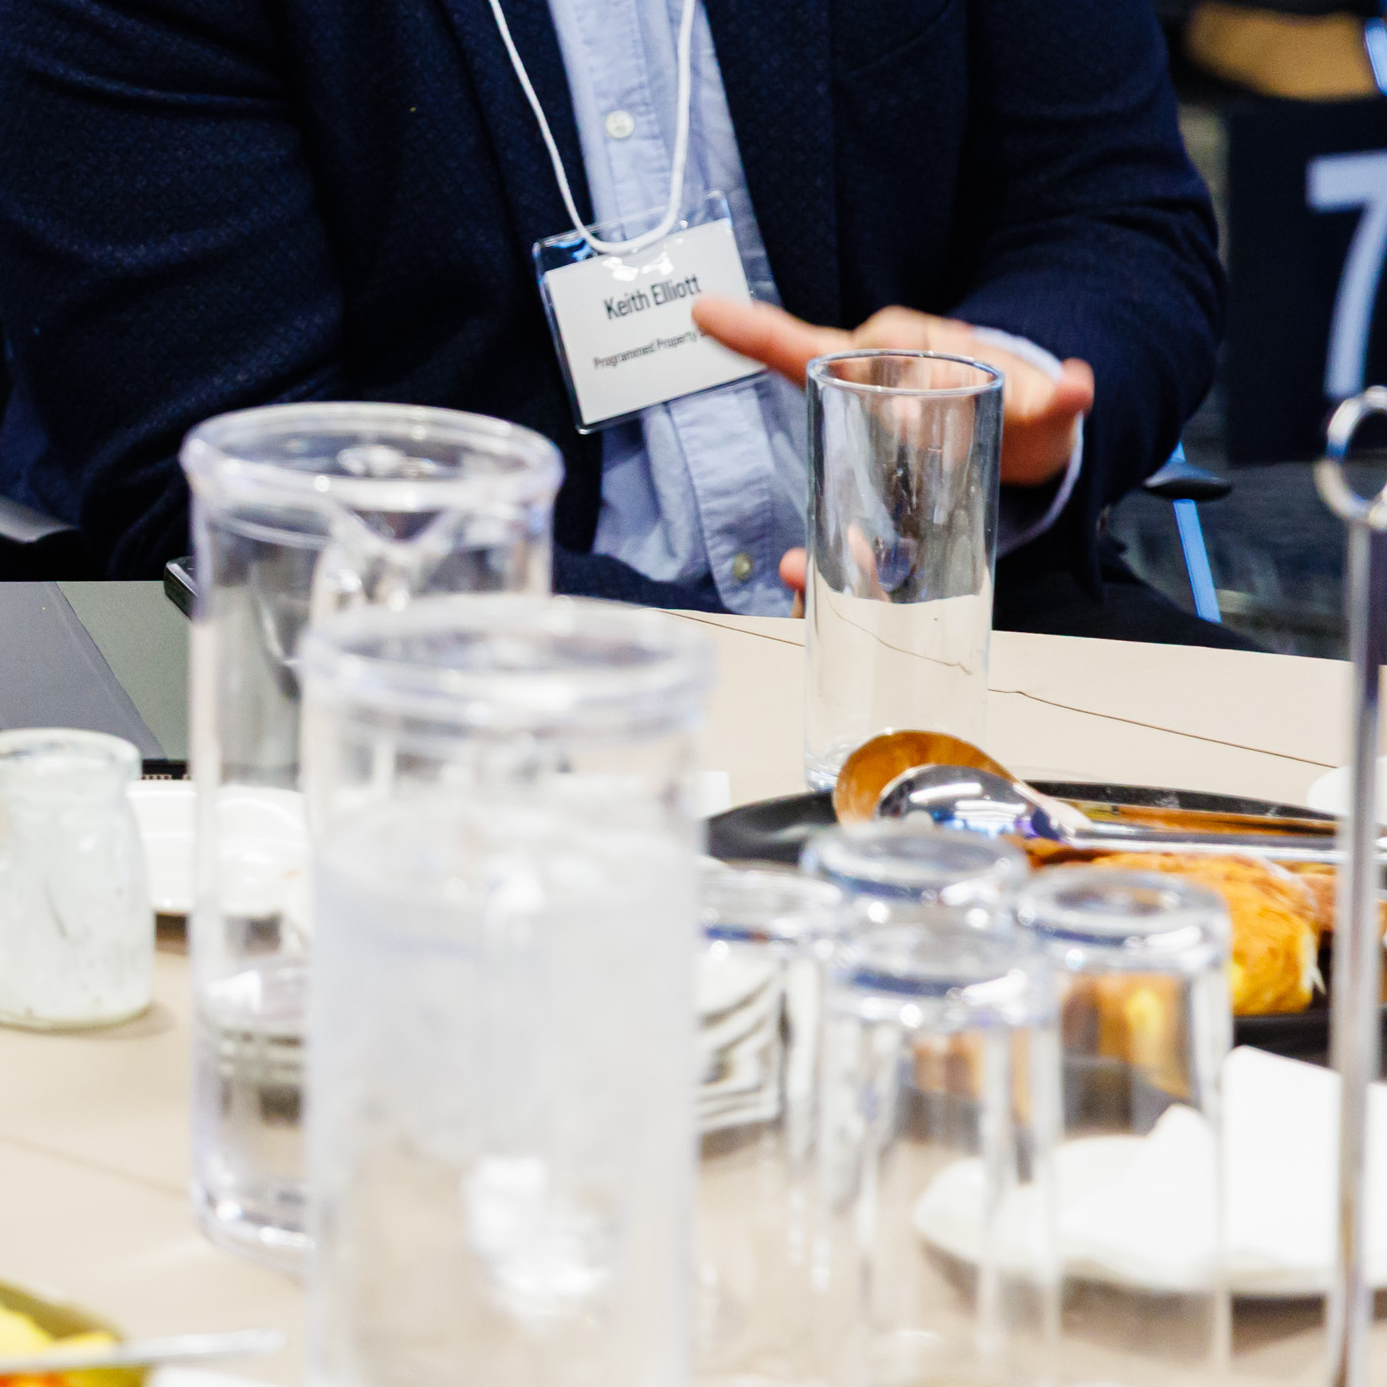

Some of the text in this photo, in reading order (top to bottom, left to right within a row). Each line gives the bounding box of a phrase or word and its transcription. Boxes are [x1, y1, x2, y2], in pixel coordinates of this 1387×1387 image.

[603, 274, 702, 320] Keith Elliott
[1305, 150, 1387, 398] 7
[593, 342, 655, 369] Programmed
